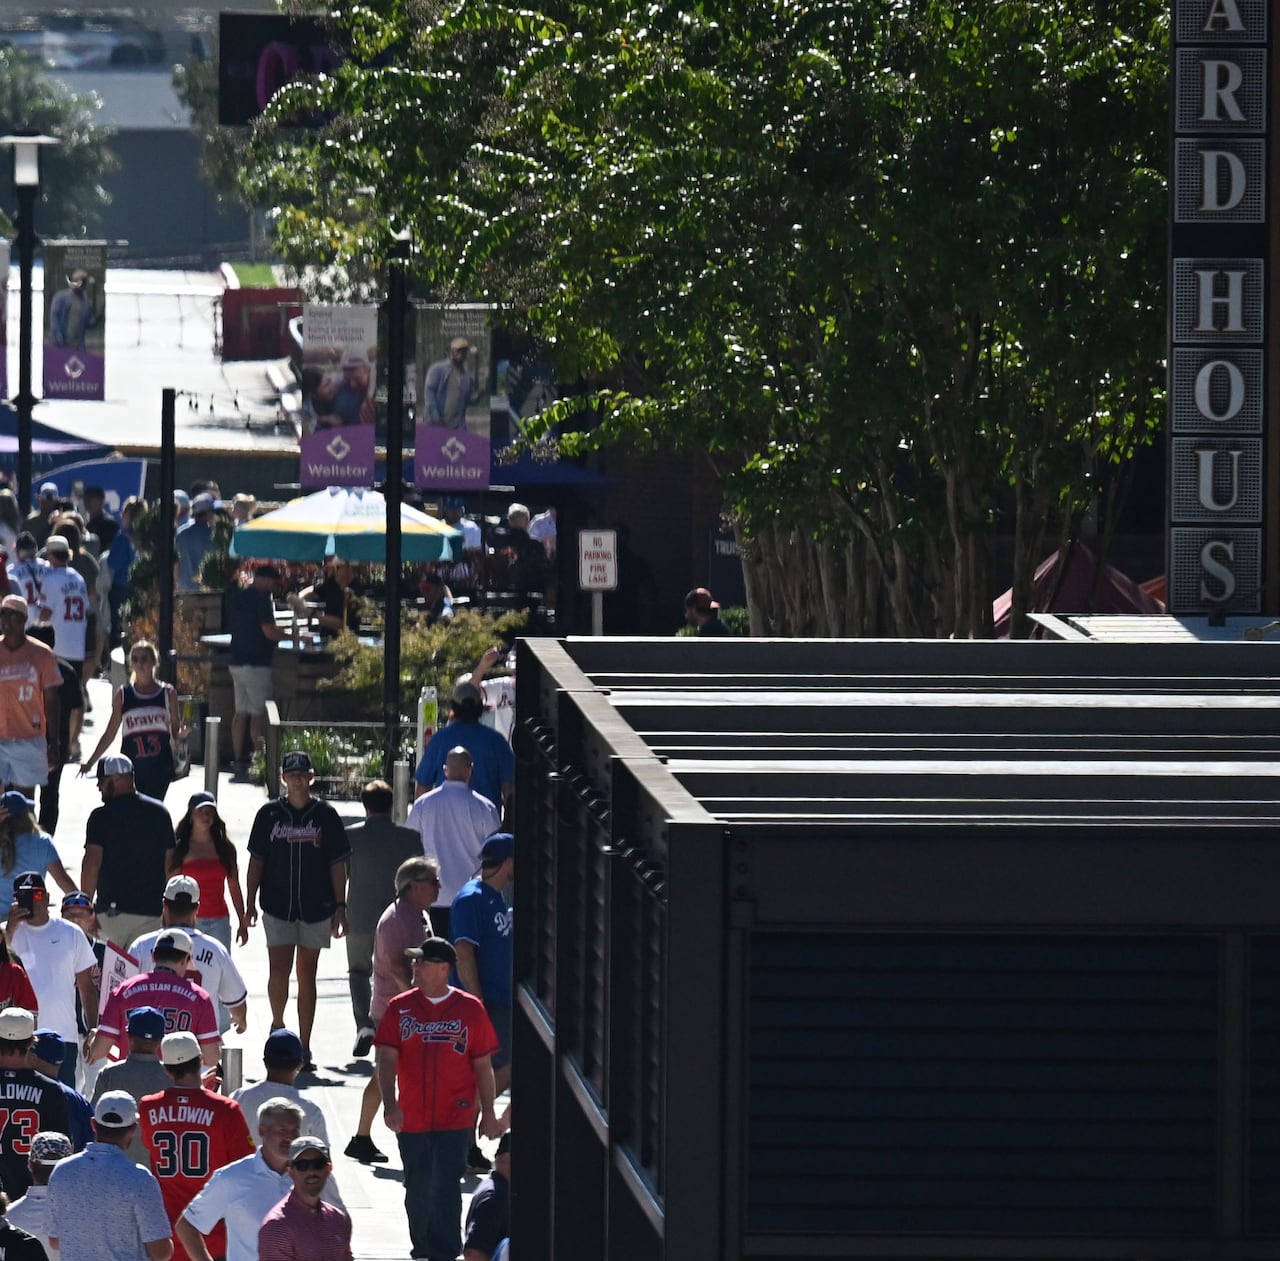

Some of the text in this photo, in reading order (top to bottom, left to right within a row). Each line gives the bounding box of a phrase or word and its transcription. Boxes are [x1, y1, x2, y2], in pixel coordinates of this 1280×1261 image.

[49, 380, 99, 392] Wellstar
[1193, 269, 1248, 602] HOUS
[307, 463, 369, 478] Wellstar
[423, 464, 483, 479] Wellstar
[593, 535, 603, 548] NO
[715, 540, 742, 556] TRUIS
[583, 551, 612, 561] PARKING
[590, 563, 606, 574] FIRE
[589, 574, 608, 584] LANE
[64, 598, 85, 621] 13
[18, 684, 34, 702] 13
[132, 733, 162, 758] 13
[196, 947, 213, 968] JR.
[122, 982, 197, 1002] GRAND SLAM SELLER
[399, 1016, 462, 1041] Braves
[148, 1106, 215, 1127] BALDWIN
[152, 1130, 210, 1178] 30
